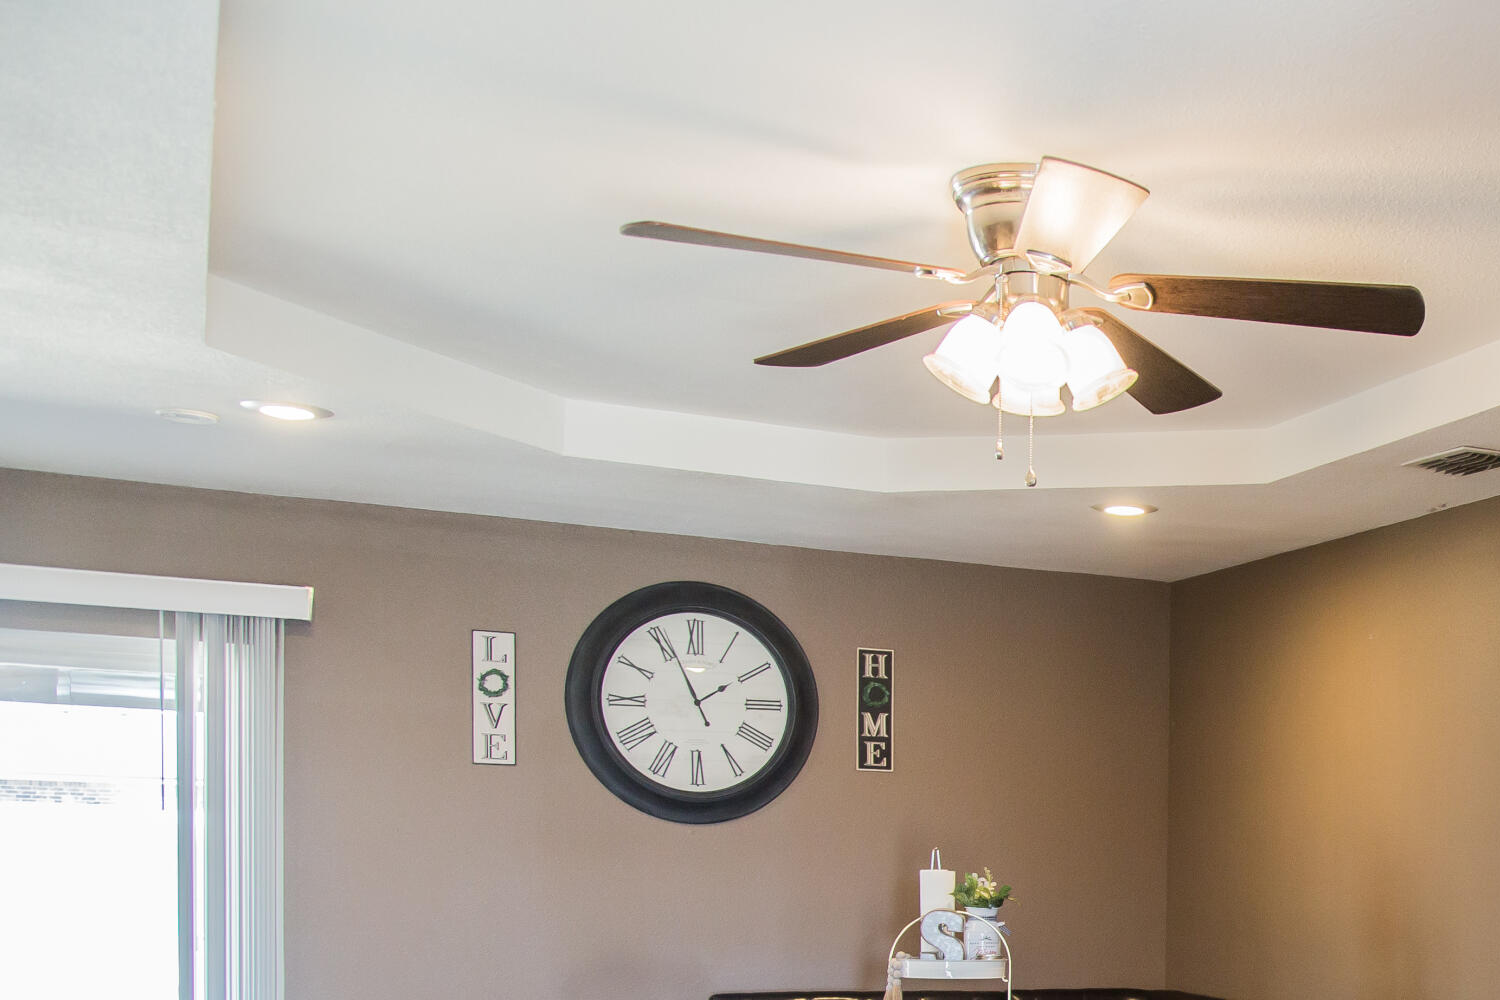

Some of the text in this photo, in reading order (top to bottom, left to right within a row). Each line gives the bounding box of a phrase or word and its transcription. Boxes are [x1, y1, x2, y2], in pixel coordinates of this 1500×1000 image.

[686, 618, 705, 656] XII
[617, 655, 655, 681] X
[744, 697, 783, 712] III
